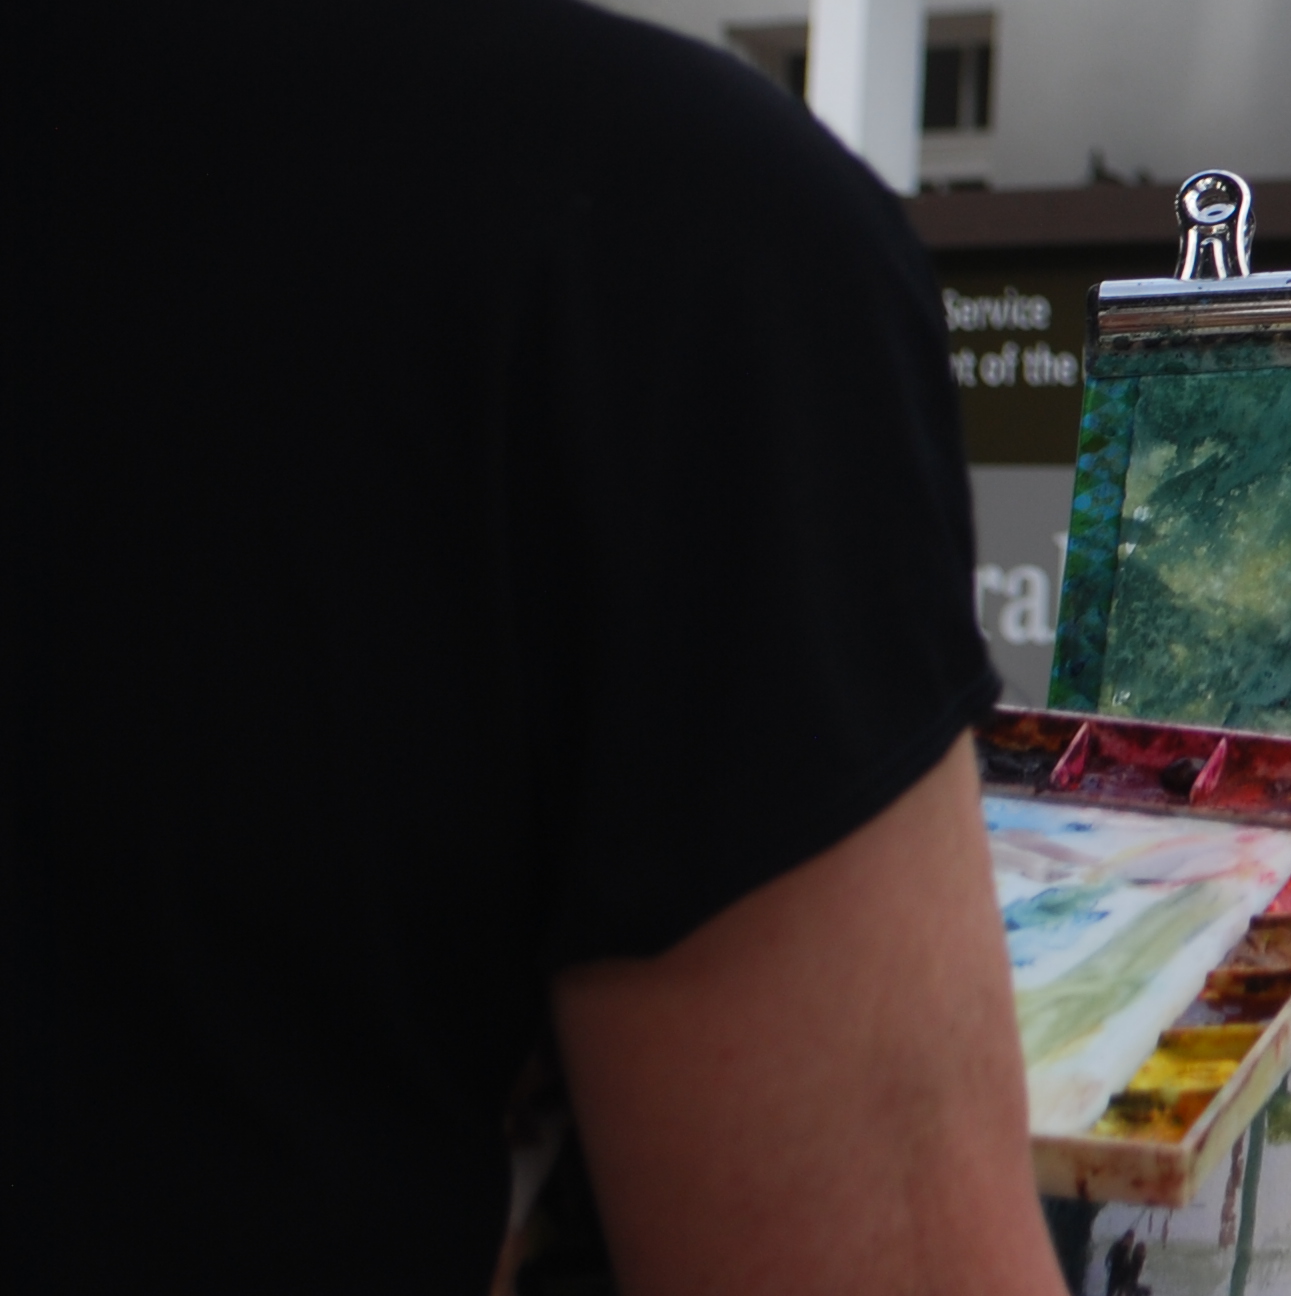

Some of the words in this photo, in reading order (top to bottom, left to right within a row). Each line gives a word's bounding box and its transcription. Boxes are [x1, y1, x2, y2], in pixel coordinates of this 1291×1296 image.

[943, 287, 1050, 331] Service
[980, 341, 1019, 387] of
[1023, 342, 1079, 387] the
